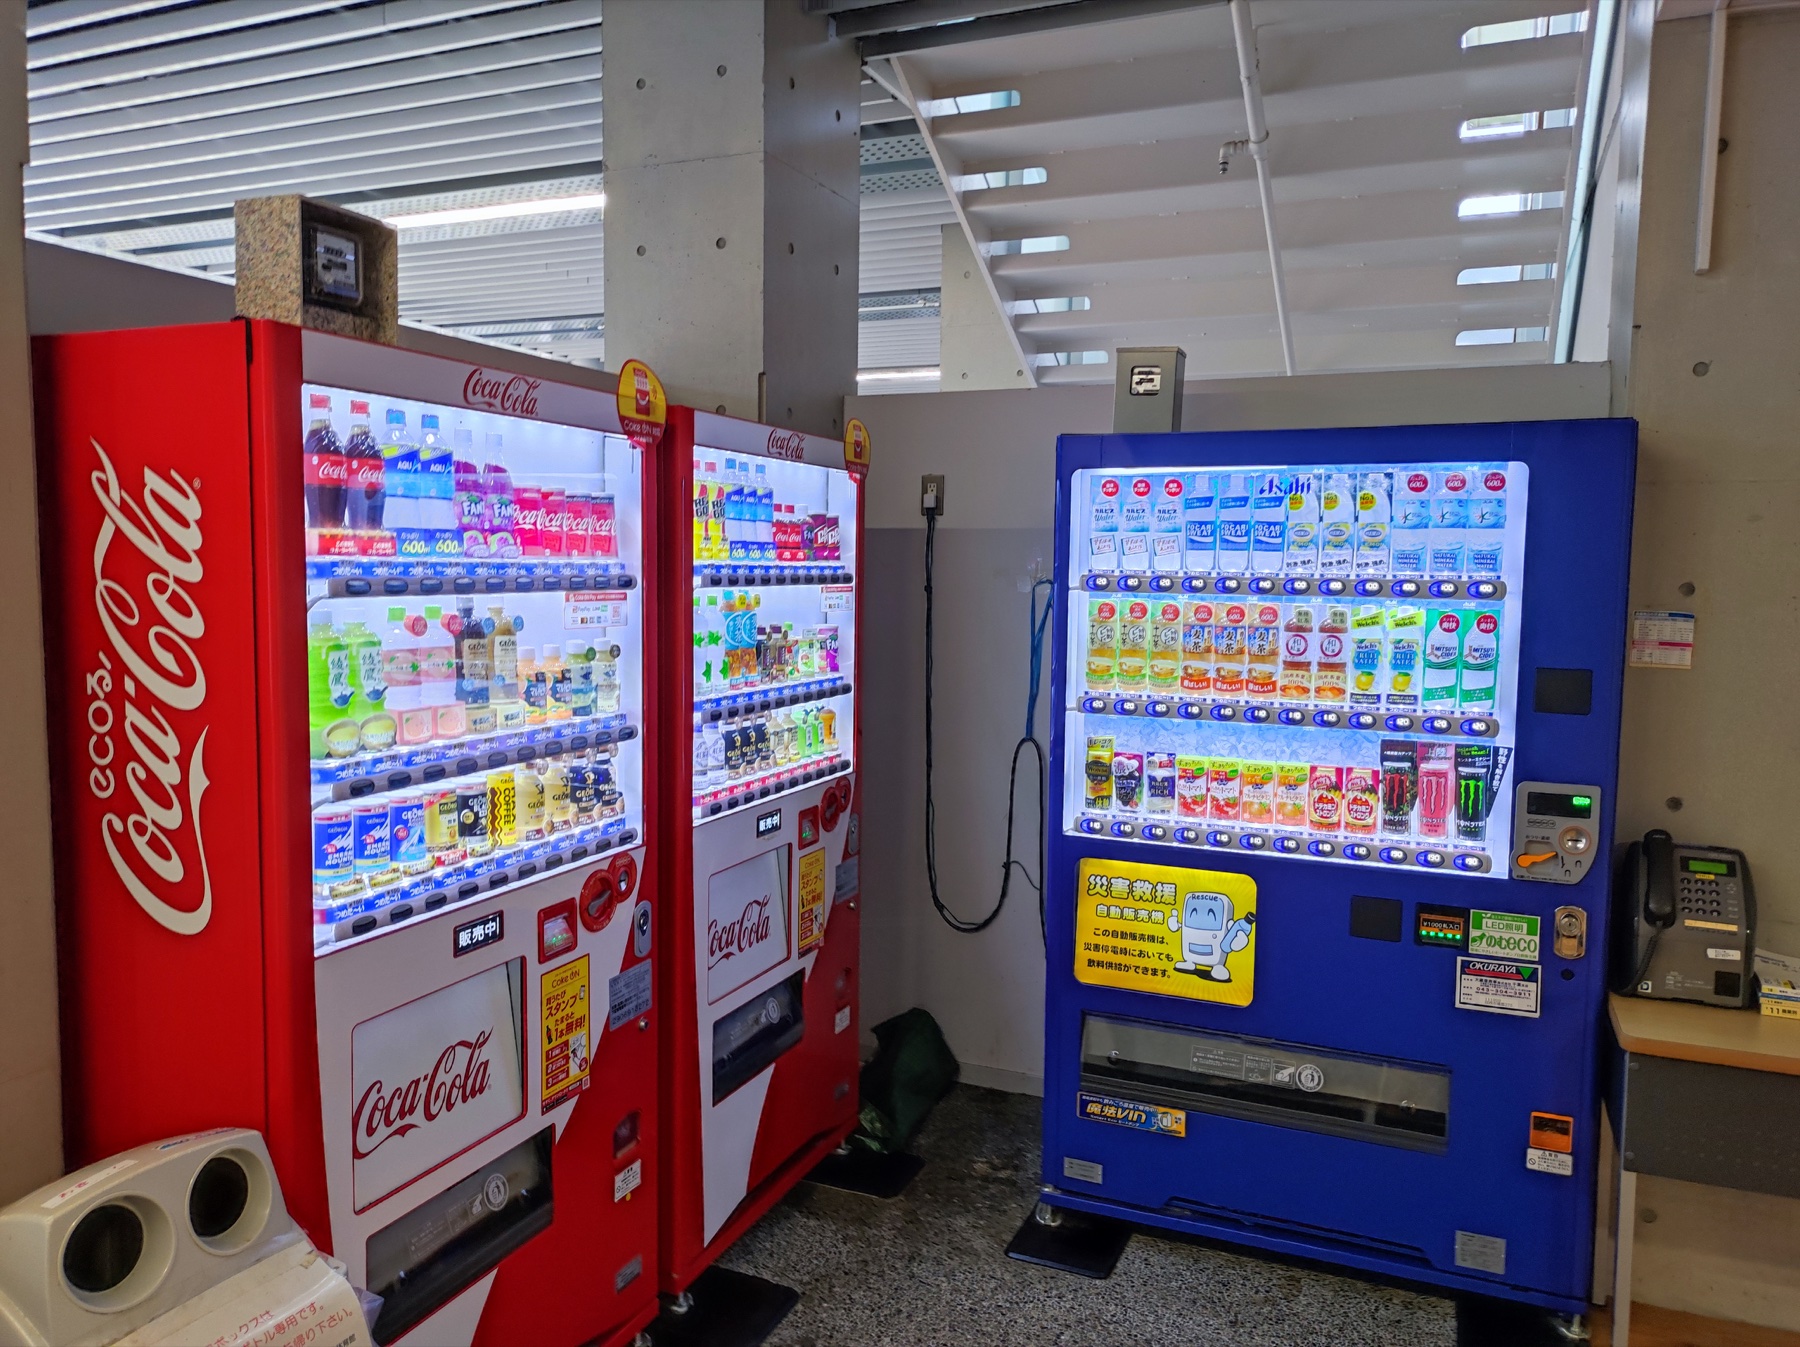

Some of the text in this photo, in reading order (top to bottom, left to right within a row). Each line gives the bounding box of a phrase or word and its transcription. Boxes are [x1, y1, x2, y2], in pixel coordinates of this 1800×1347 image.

[463, 368, 541, 416] Coca-Cola
[767, 429, 806, 460] Coca-Cola
[1259, 476, 1311, 495] Asahi
[402, 540, 430, 554] 600ml
[436, 540, 463, 553] 600ml
[1357, 620, 1379, 628] Welch's
[1394, 620, 1416, 628] Welch's
[1192, 629, 1202, 652] 麦茶
[1225, 630, 1234, 653] 麦茶
[1257, 631, 1266, 653] 麦茶
[330, 654, 344, 688] 綾鷹
[362, 653, 376, 682] 綾鷹
[90, 436, 213, 935] Coca-Cola
[504, 788, 512, 826] COFFEE
[759, 814, 779, 832] 販売中
[1087, 874, 1177, 905] 災害救援
[1191, 894, 1219, 902] Rescue
[1096, 904, 1165, 925] 自動販売機
[458, 915, 495, 948] 販売中
[708, 893, 772, 972] Coca-Cola
[1485, 921, 1524, 932] LED照明
[1093, 928, 1169, 946] この自動販売機は、
[1486, 935, 1538, 953] のむeco
[1084, 942, 1174, 962] 災害停電時においても
[1087, 958, 1171, 978] 飲料供給ができます。
[1470, 962, 1516, 974] OKURAYA
[552, 969, 580, 988] Coke ON
[546, 989, 566, 1007] 買うたび
[546, 993, 578, 1020] スタンプ
[555, 1012, 574, 1027] たまると
[555, 1014, 586, 1041] 1本無料!
[353, 1025, 495, 1160] Coca-Cola
